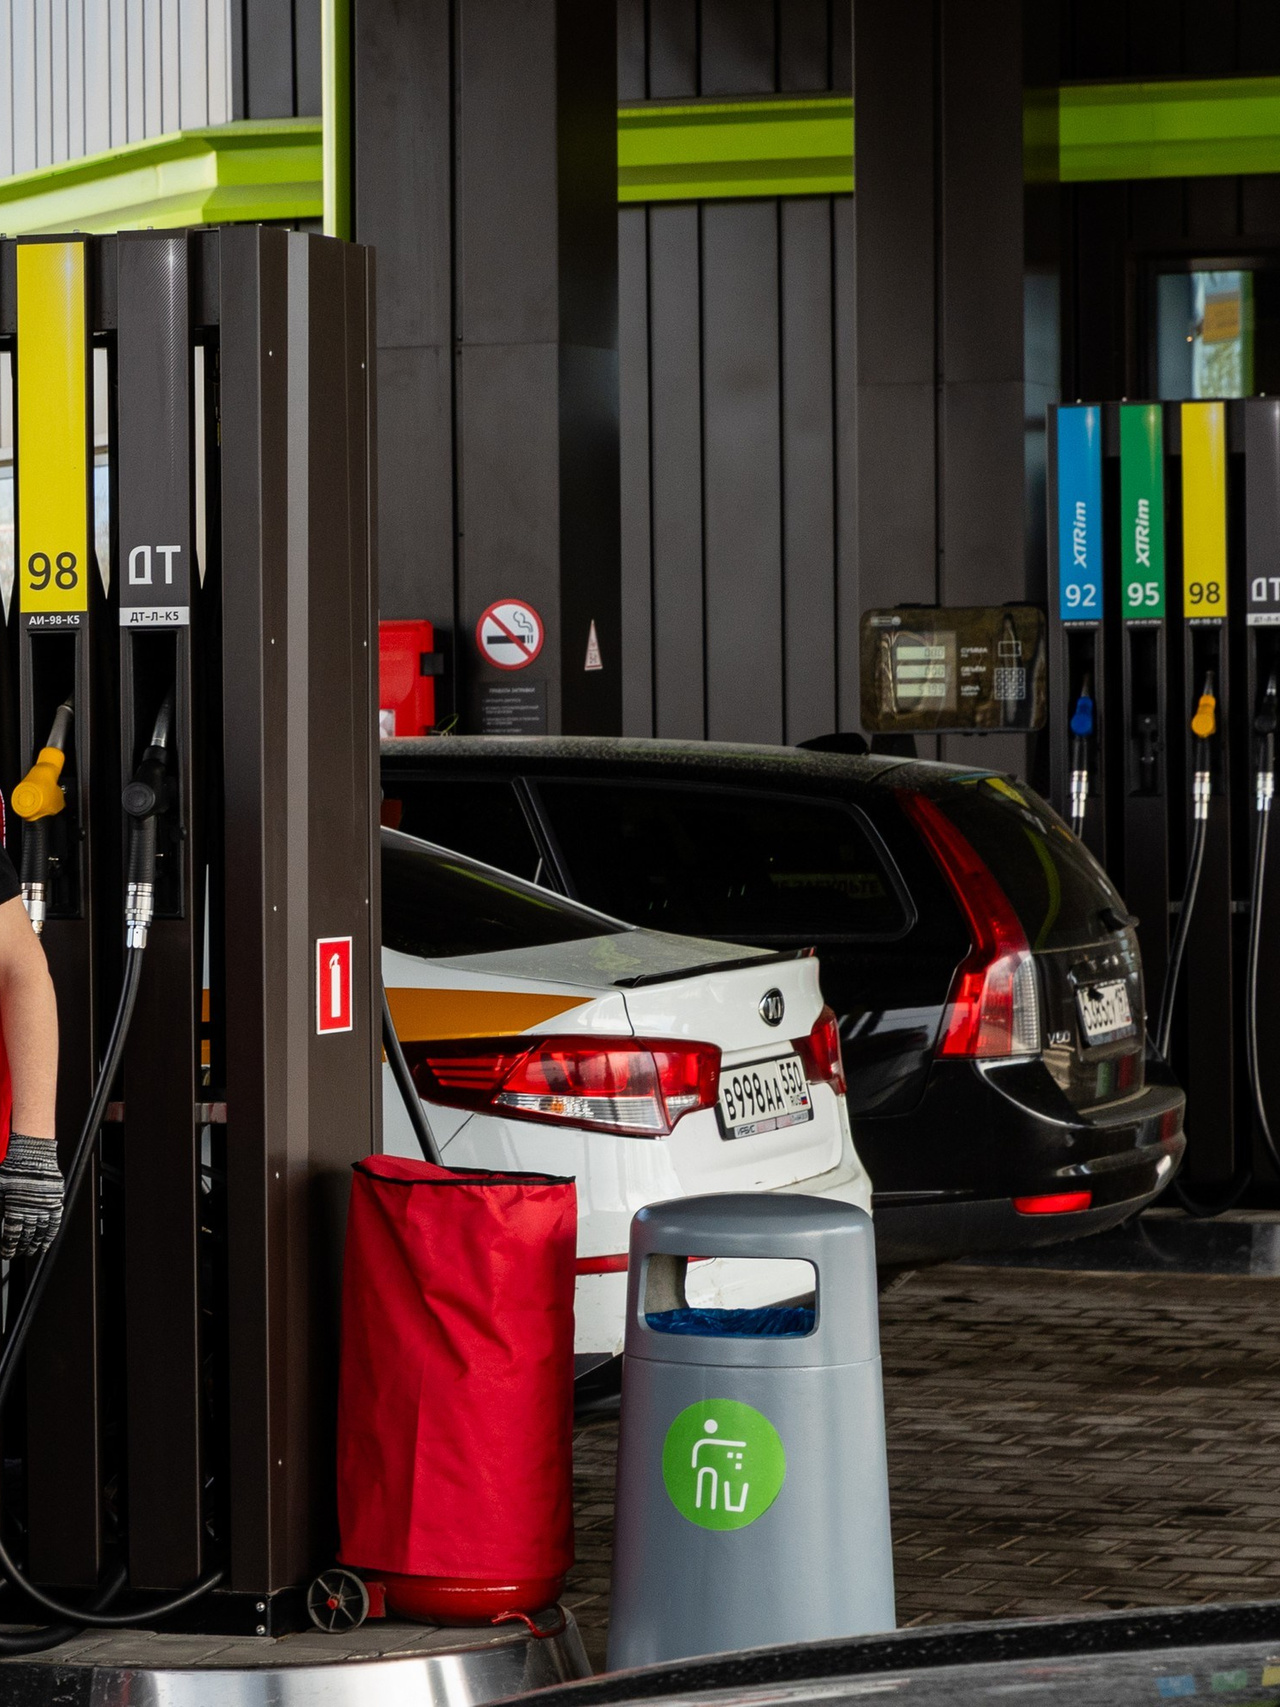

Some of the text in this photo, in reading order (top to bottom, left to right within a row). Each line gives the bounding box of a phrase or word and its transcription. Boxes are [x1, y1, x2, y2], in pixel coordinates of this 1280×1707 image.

[1073, 501, 1087, 569] XTRim
[1135, 498, 1150, 568] XTRim
[27, 550, 79, 591] 98
[128, 544, 182, 586] ДТ
[1065, 583, 1097, 608] 92
[1127, 582, 1160, 607] 95
[1188, 581, 1221, 605] 98
[29, 613, 81, 626] АИ-98-К5
[129, 610, 180, 624] ДТ-Л-К5
[723, 1061, 803, 1121] В998АА 550
